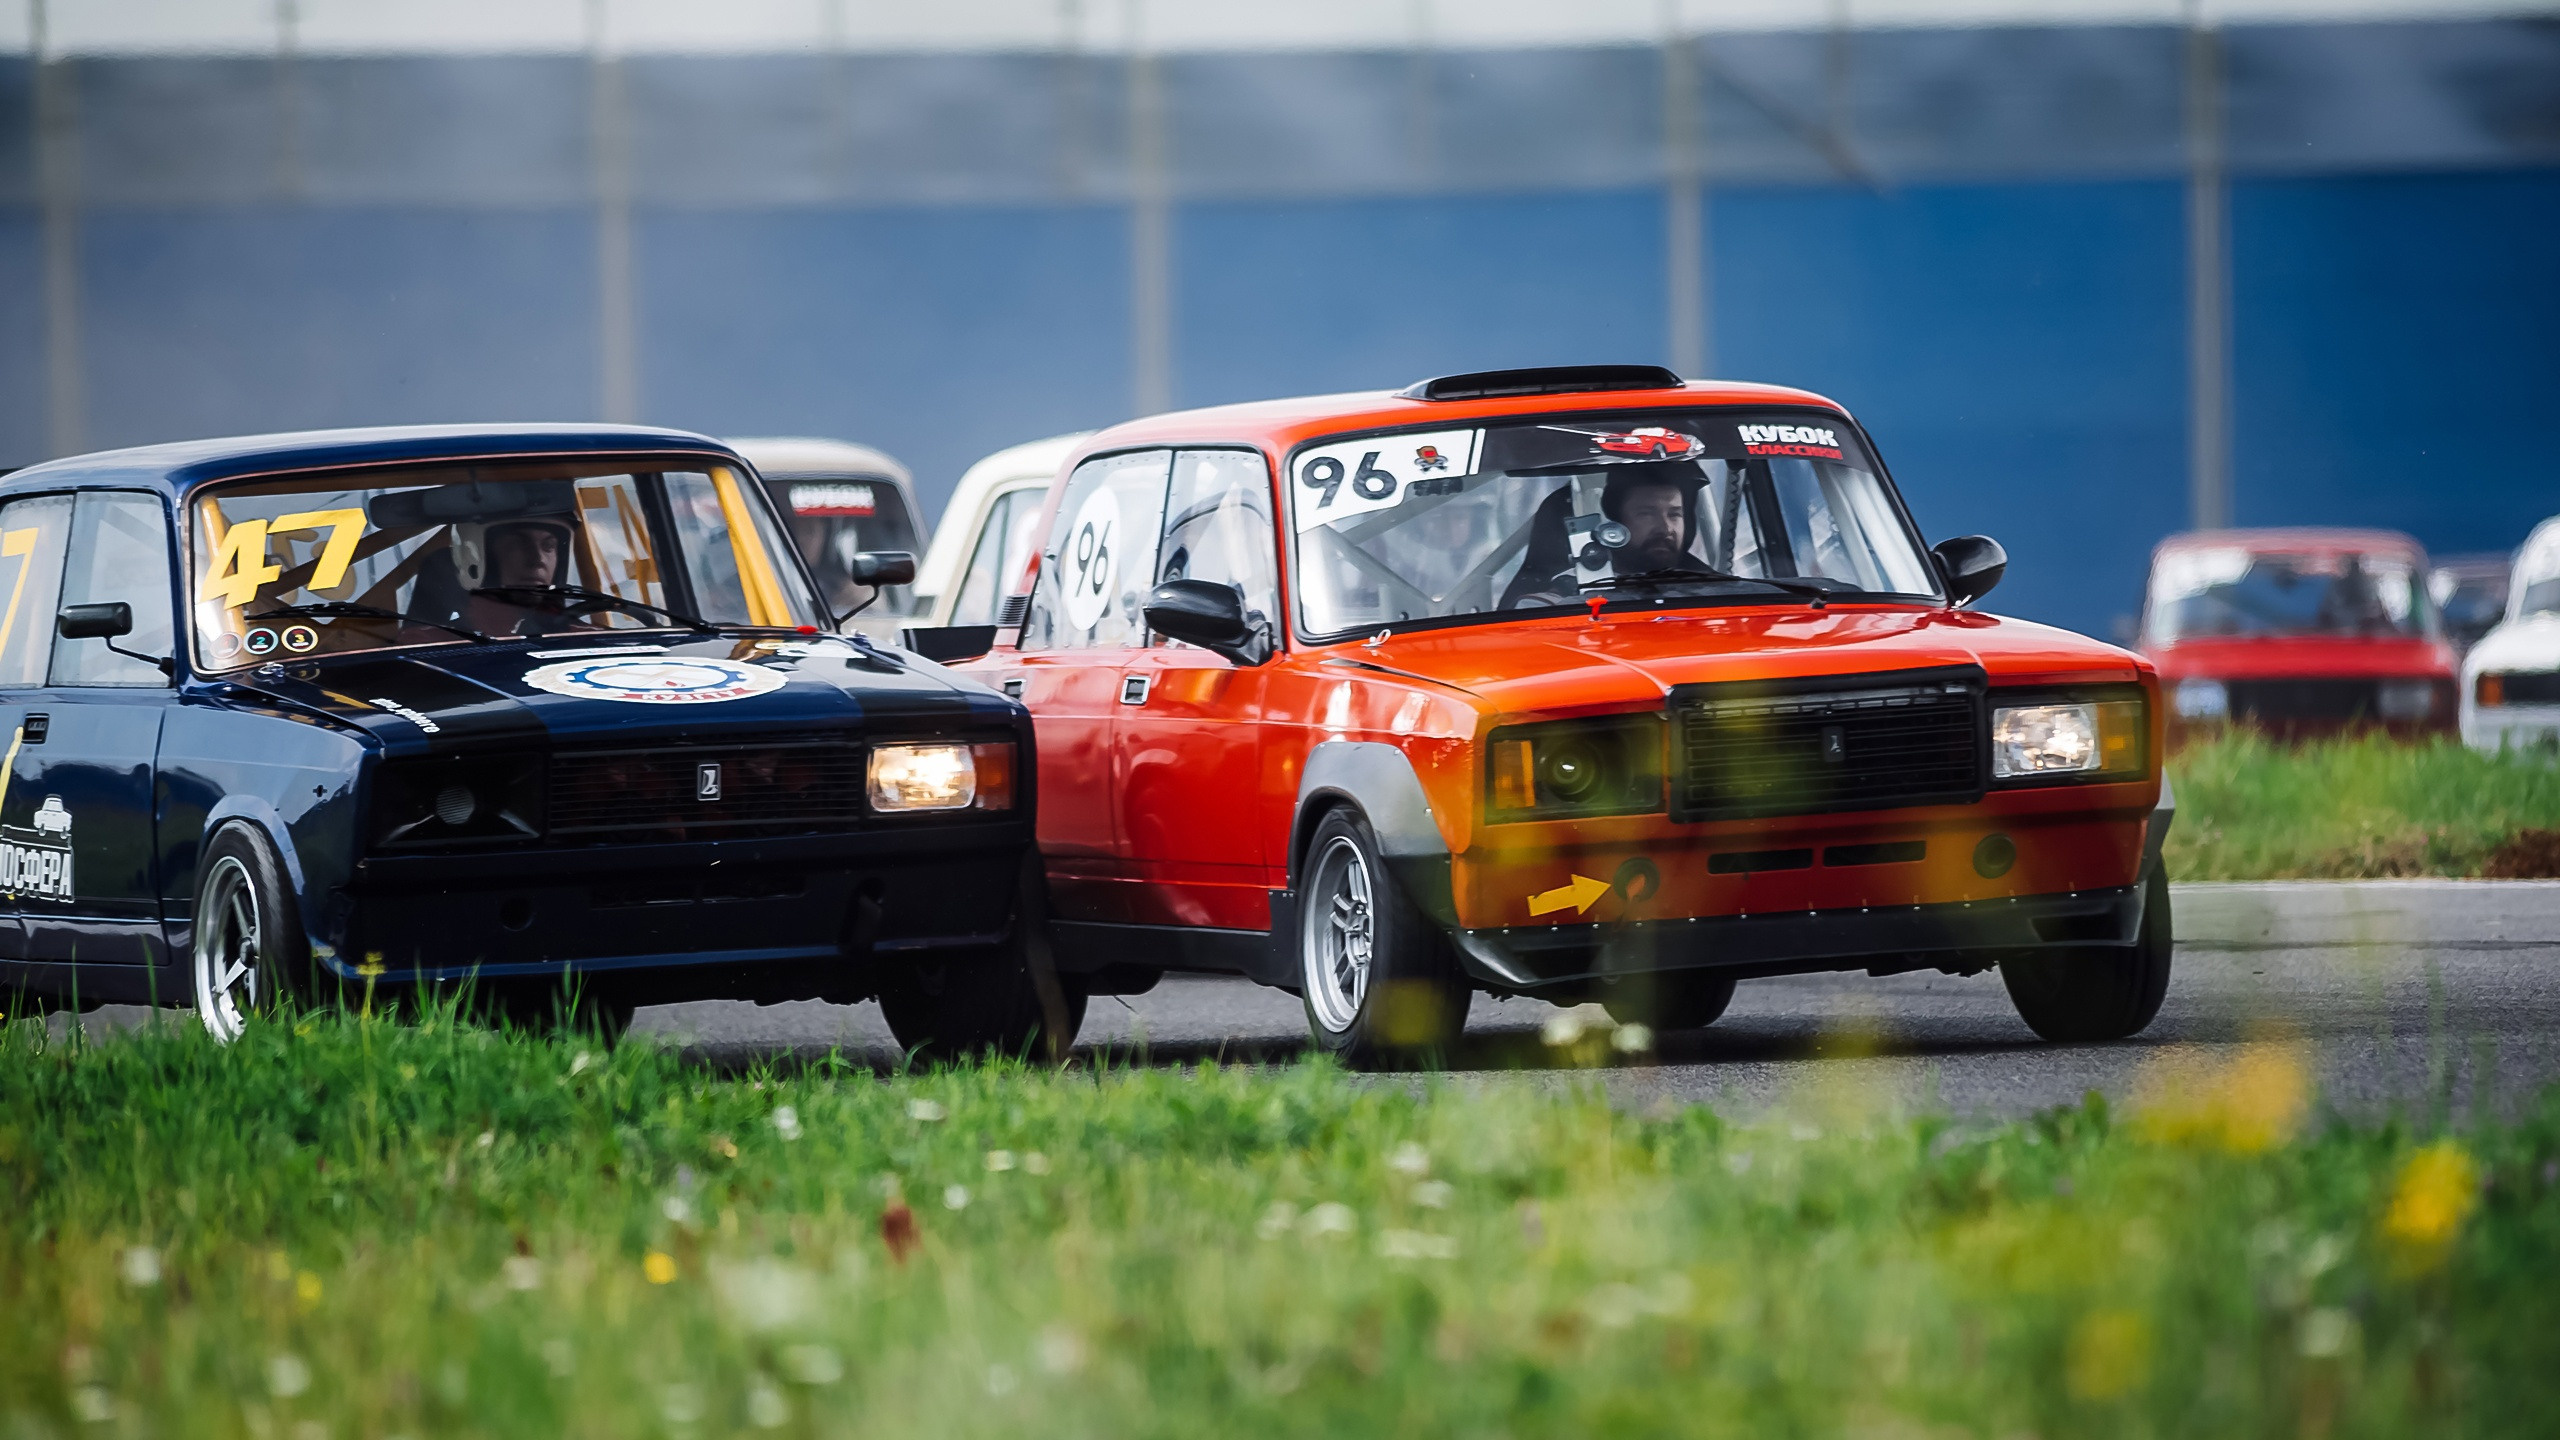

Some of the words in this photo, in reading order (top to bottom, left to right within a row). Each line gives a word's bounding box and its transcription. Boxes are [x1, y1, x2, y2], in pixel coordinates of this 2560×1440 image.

[1737, 424, 1840, 447] КУБОК
[1301, 451, 1398, 511] 96
[201, 507, 368, 610] 47
[1075, 519, 1110, 598] 96
[256, 636, 266, 646] 2
[294, 633, 305, 644] 3
